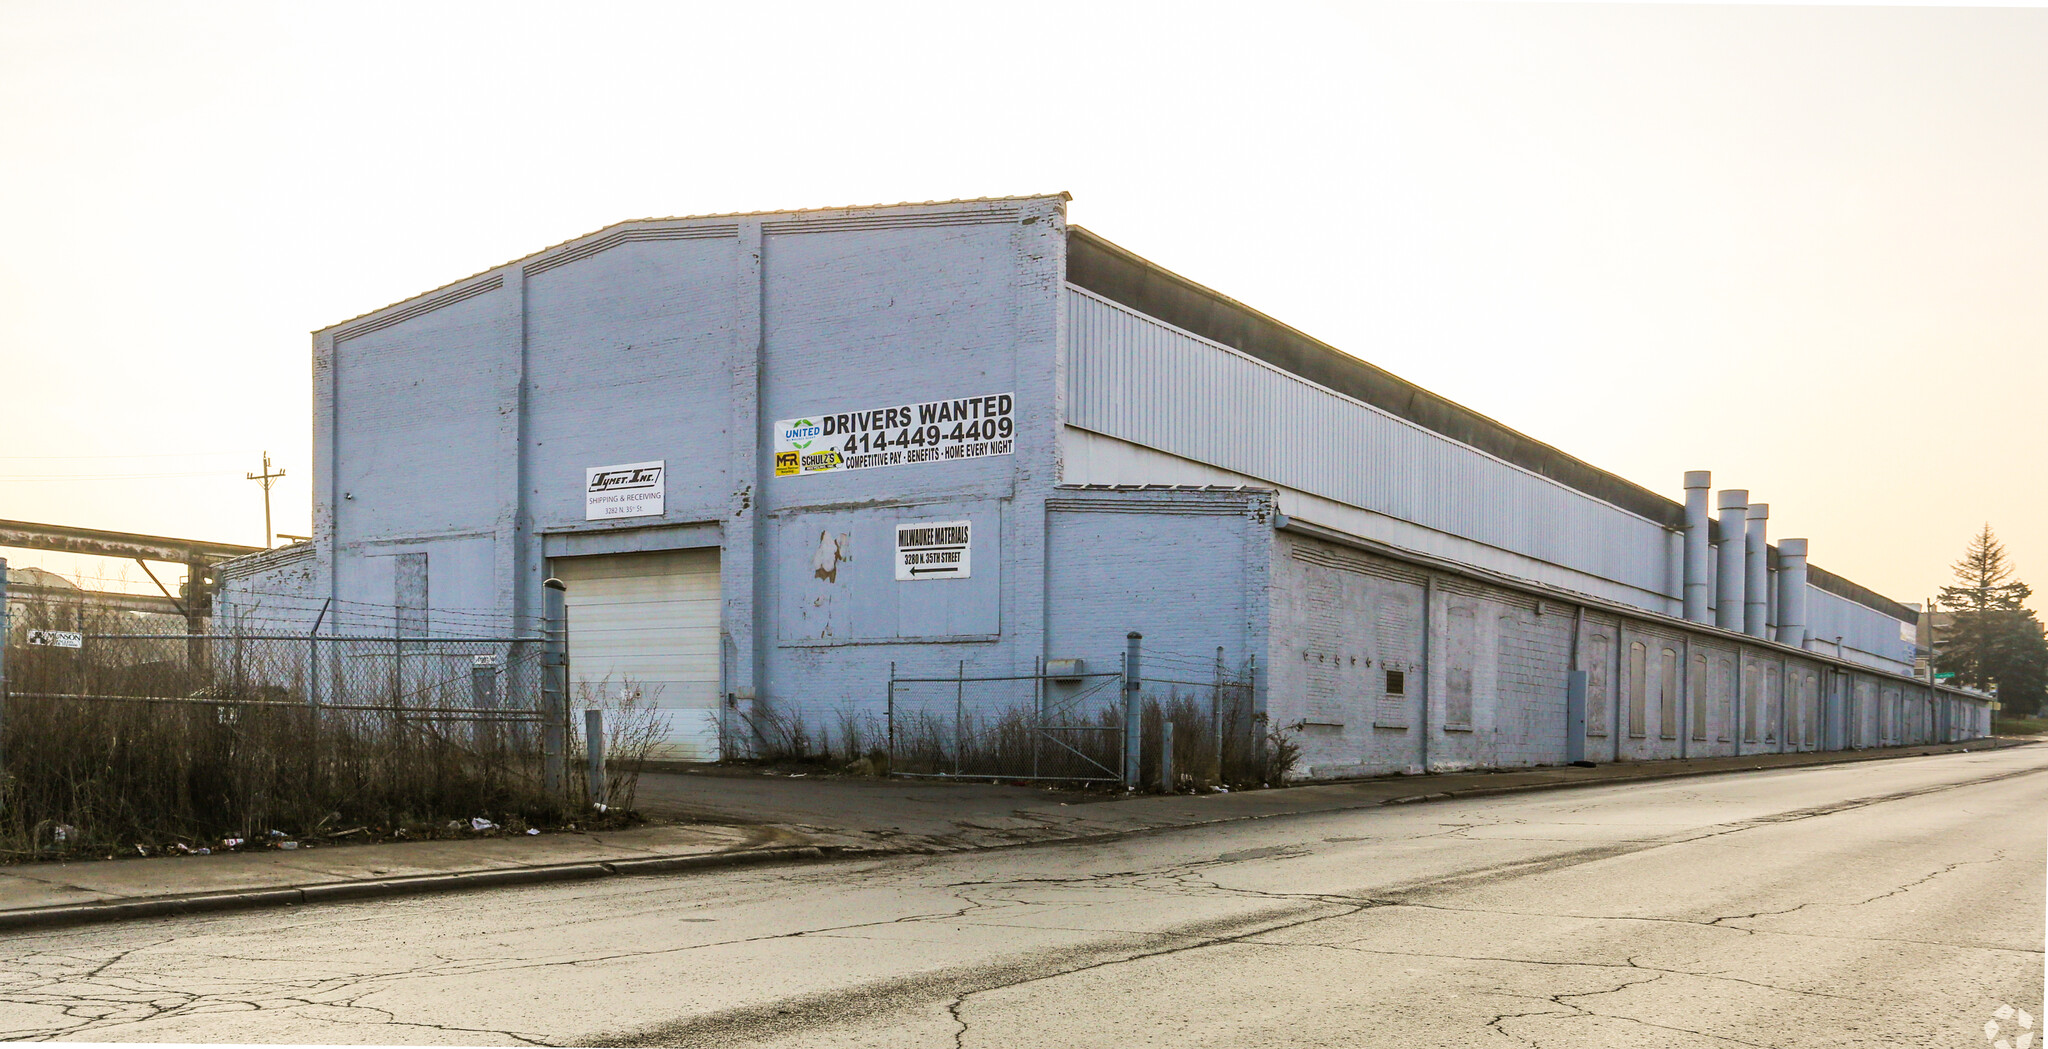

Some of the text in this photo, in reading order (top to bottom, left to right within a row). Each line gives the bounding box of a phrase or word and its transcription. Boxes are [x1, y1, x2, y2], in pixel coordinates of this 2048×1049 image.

[823, 395, 1013, 436] DRIVERS WANTED
[786, 427, 820, 438] UNITED
[844, 417, 1013, 454] 414-449-4409
[776, 453, 798, 466] MFR
[801, 453, 835, 466] SCHULZ'S
[846, 453, 888, 469] COMPETITIVE
[889, 452, 902, 465] PAY
[907, 447, 940, 463] BENEFITS
[945, 444, 965, 459] HOME
[966, 442, 989, 458] EVERY
[990, 439, 1013, 454] NIGHT
[589, 495, 619, 505] SHIPPING
[627, 492, 662, 501] RECEIVING
[605, 507, 618, 515] 3282
[626, 505, 636, 513] 35
[899, 526, 968, 546] MILWAUKEE MATERIALS
[920, 554, 925, 564] N.
[926, 553, 941, 564] 35TH
[941, 552, 960, 562] STREET
